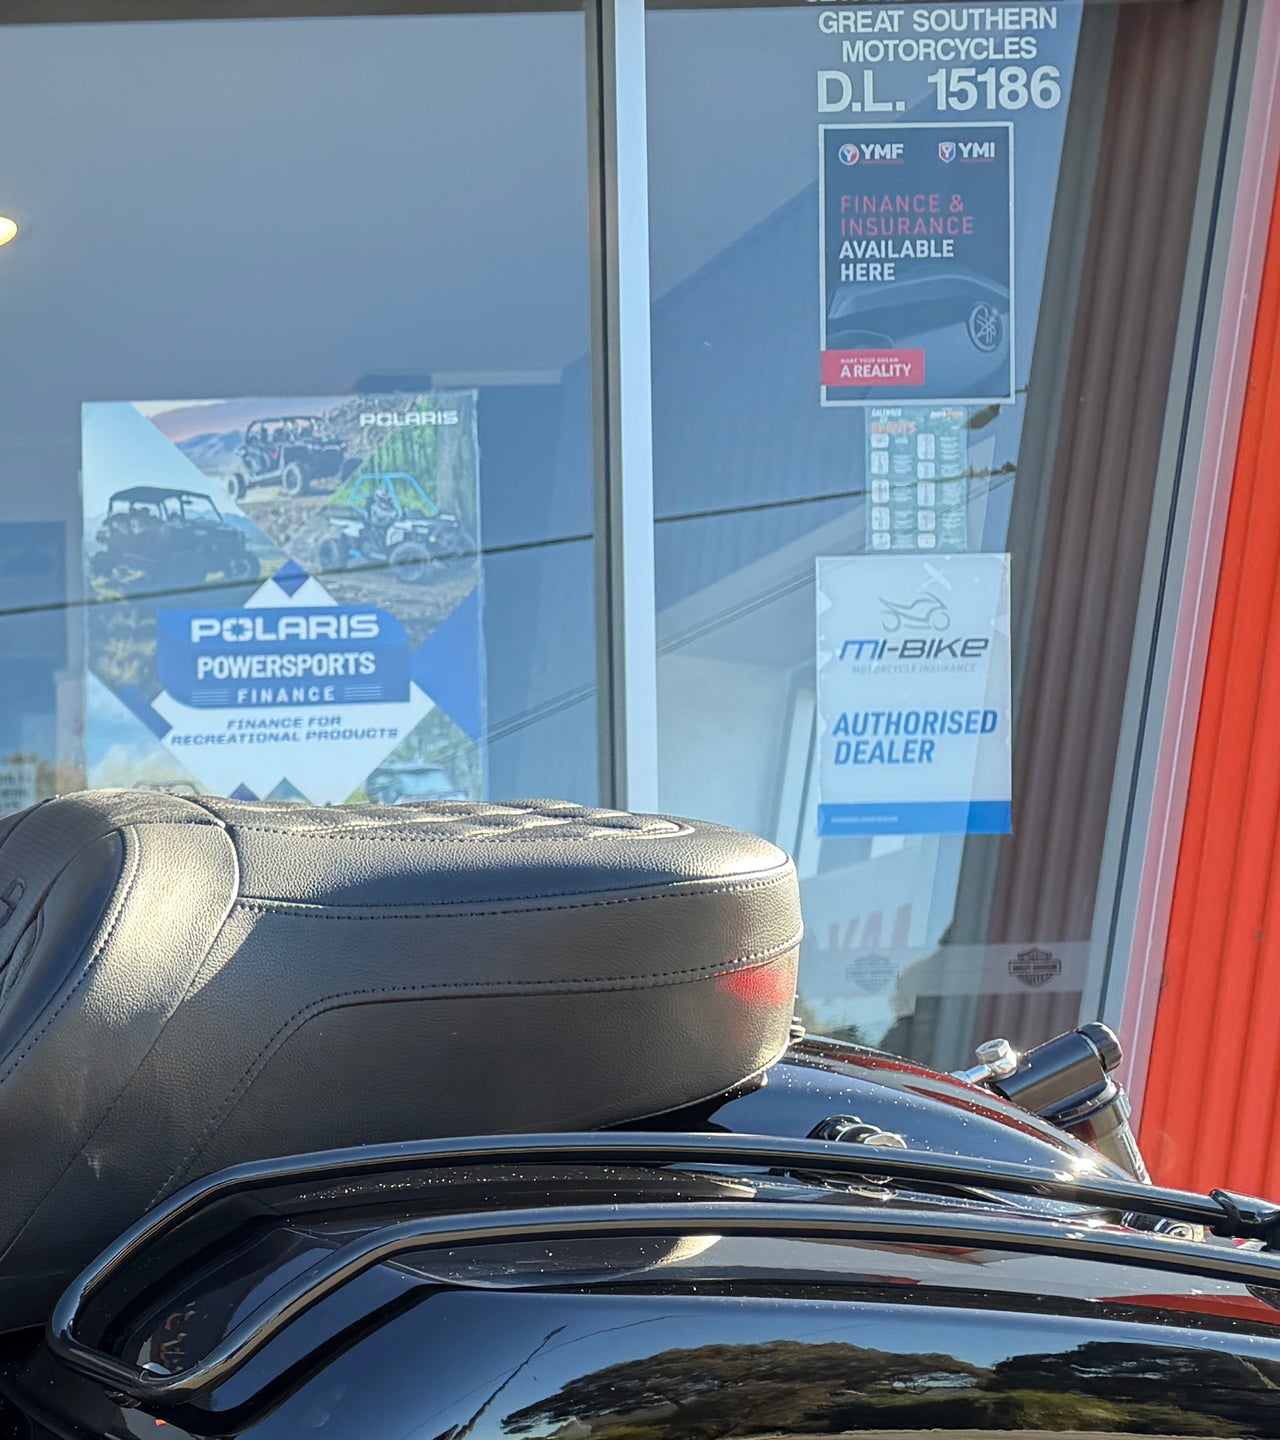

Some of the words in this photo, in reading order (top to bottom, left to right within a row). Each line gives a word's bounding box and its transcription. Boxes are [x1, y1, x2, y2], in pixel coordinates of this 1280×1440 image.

[818, 10, 905, 33] GREAT
[912, 7, 1057, 32] SOUTHERN
[842, 37, 1038, 62] MOTORCYCLES
[817, 70, 906, 112] D.L.
[927, 66, 1061, 110] 15186
[860, 143, 904, 160] YMF
[958, 142, 996, 158] YMI
[841, 194, 941, 213] FINANCE
[949, 194, 965, 213] &
[841, 216, 974, 236] INSURANCE
[839, 239, 955, 259] AVAILABLE
[840, 263, 896, 281] HERE
[841, 364, 852, 378] A
[853, 363, 912, 377] REALITY
[359, 410, 459, 427] POLARIS
[191, 613, 380, 643] POLARIS
[196, 652, 376, 680] POWERSPORTS
[238, 685, 337, 704] FINANCE
[227, 717, 304, 731] FINANCE
[307, 715, 343, 729] FOR
[832, 709, 998, 737] AUTHORISED
[170, 732, 301, 746] RECREATIONAL
[304, 728, 399, 743] PRODUCTS
[834, 739, 936, 765] DEALER
